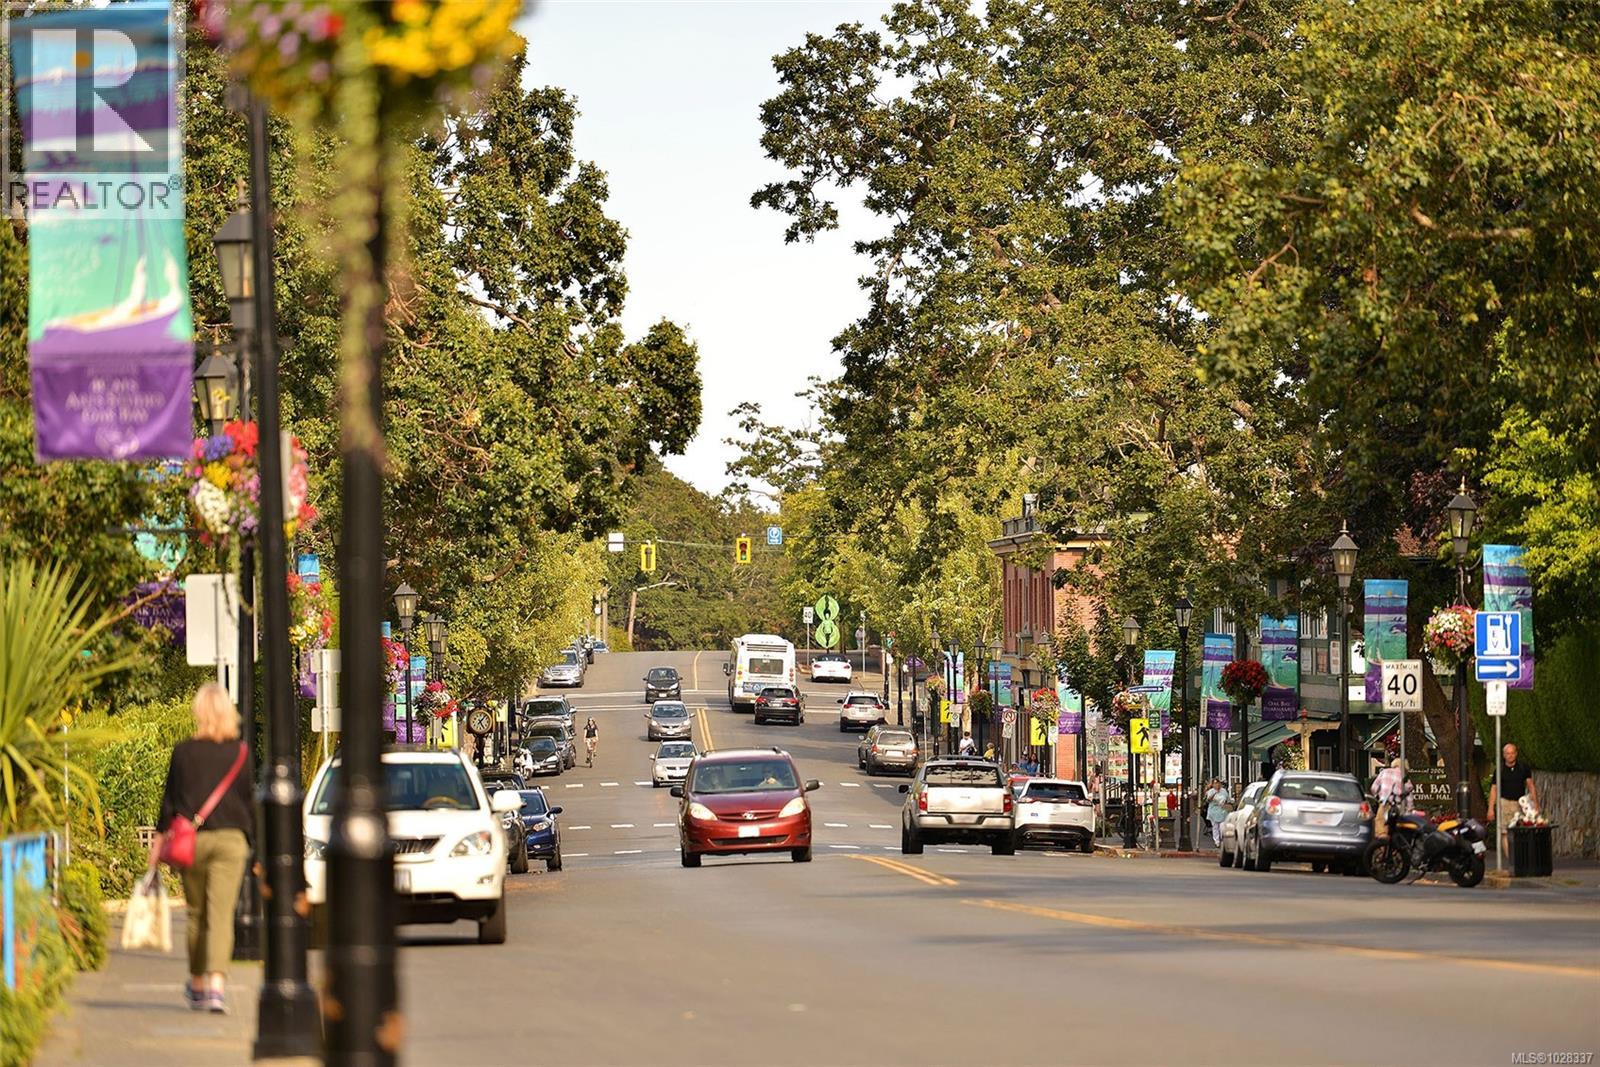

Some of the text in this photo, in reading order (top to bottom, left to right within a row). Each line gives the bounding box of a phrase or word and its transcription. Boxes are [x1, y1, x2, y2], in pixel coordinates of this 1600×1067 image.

[804, 610, 812, 619] 40
[1387, 673, 1418, 696] 40
[1389, 699, 1416, 708] km/h
